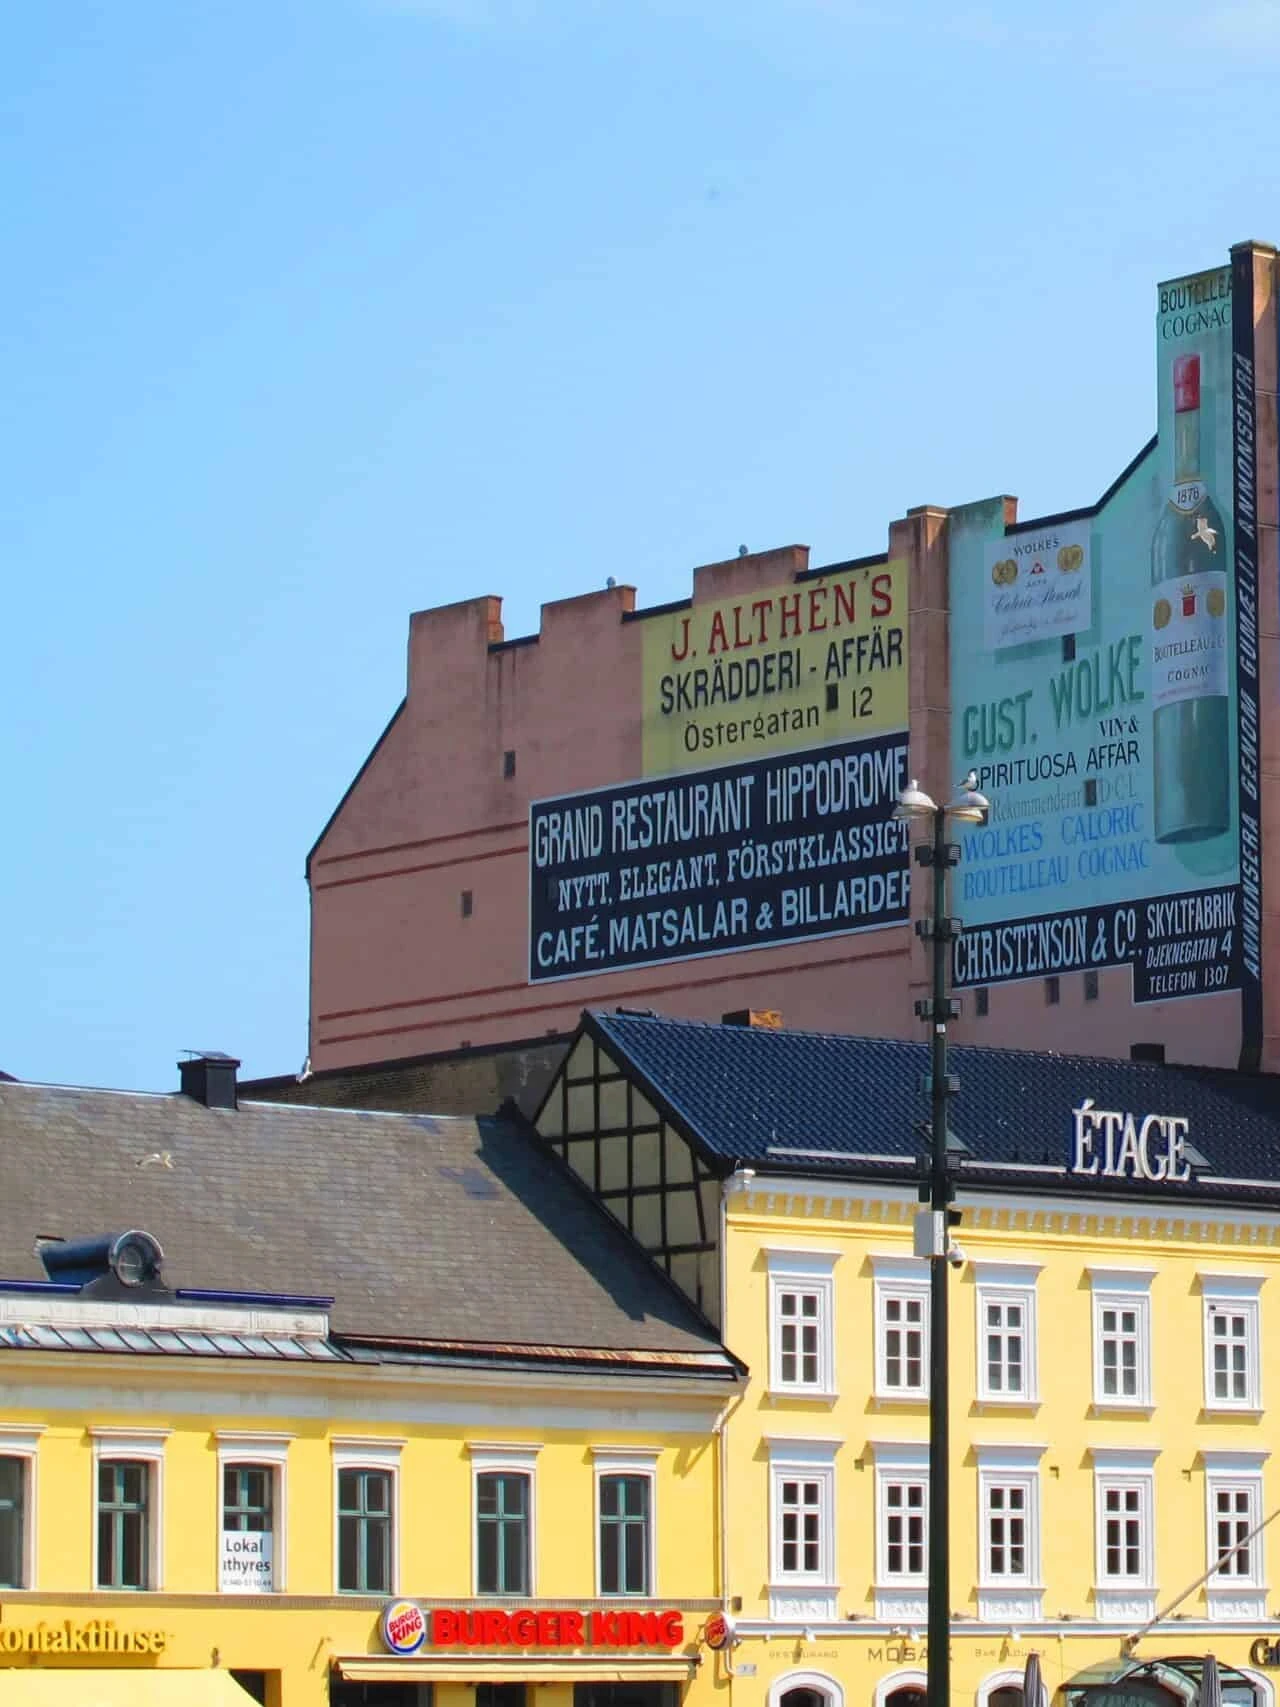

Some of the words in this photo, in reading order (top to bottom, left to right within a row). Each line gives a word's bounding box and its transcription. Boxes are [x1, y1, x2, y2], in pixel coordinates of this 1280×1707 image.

[1162, 303, 1231, 340] COGNAC
[670, 618, 698, 662] J.
[962, 689, 1039, 758] GUST.
[1049, 634, 1147, 728] WOLKE
[683, 703, 820, 752] Östergatan
[1240, 688, 1258, 801] GENOM
[535, 805, 602, 868] GRAND
[611, 775, 755, 855] RESTAURANT
[765, 745, 908, 825] HIPPODROME
[963, 821, 1044, 862] WOLKES
[1061, 802, 1145, 846] CALORIC
[963, 853, 1068, 900] BOUTELLEAU
[1077, 838, 1150, 880] COGNAC
[1146, 891, 1237, 939] SKYLTFABRIK
[1241, 813, 1260, 980] ANNONSERA
[608, 898, 748, 956] MATSALAR
[755, 905, 773, 930] &
[953, 914, 1088, 984] CHRISTENSON
[1091, 917, 1108, 962] &
[1145, 936, 1218, 970] DJEKNEGATAN
[1220, 930, 1233, 958] 4
[1149, 970, 1198, 995] TELEFON
[1203, 965, 1230, 988] 1307
[1072, 1098, 1191, 1182] ÉTAGE
[225, 1537, 265, 1553] Lokal
[387, 1607, 420, 1634] BURGER
[390, 1616, 423, 1645] KING
[431, 1610, 585, 1649] BURGER
[590, 1610, 684, 1648] KING
